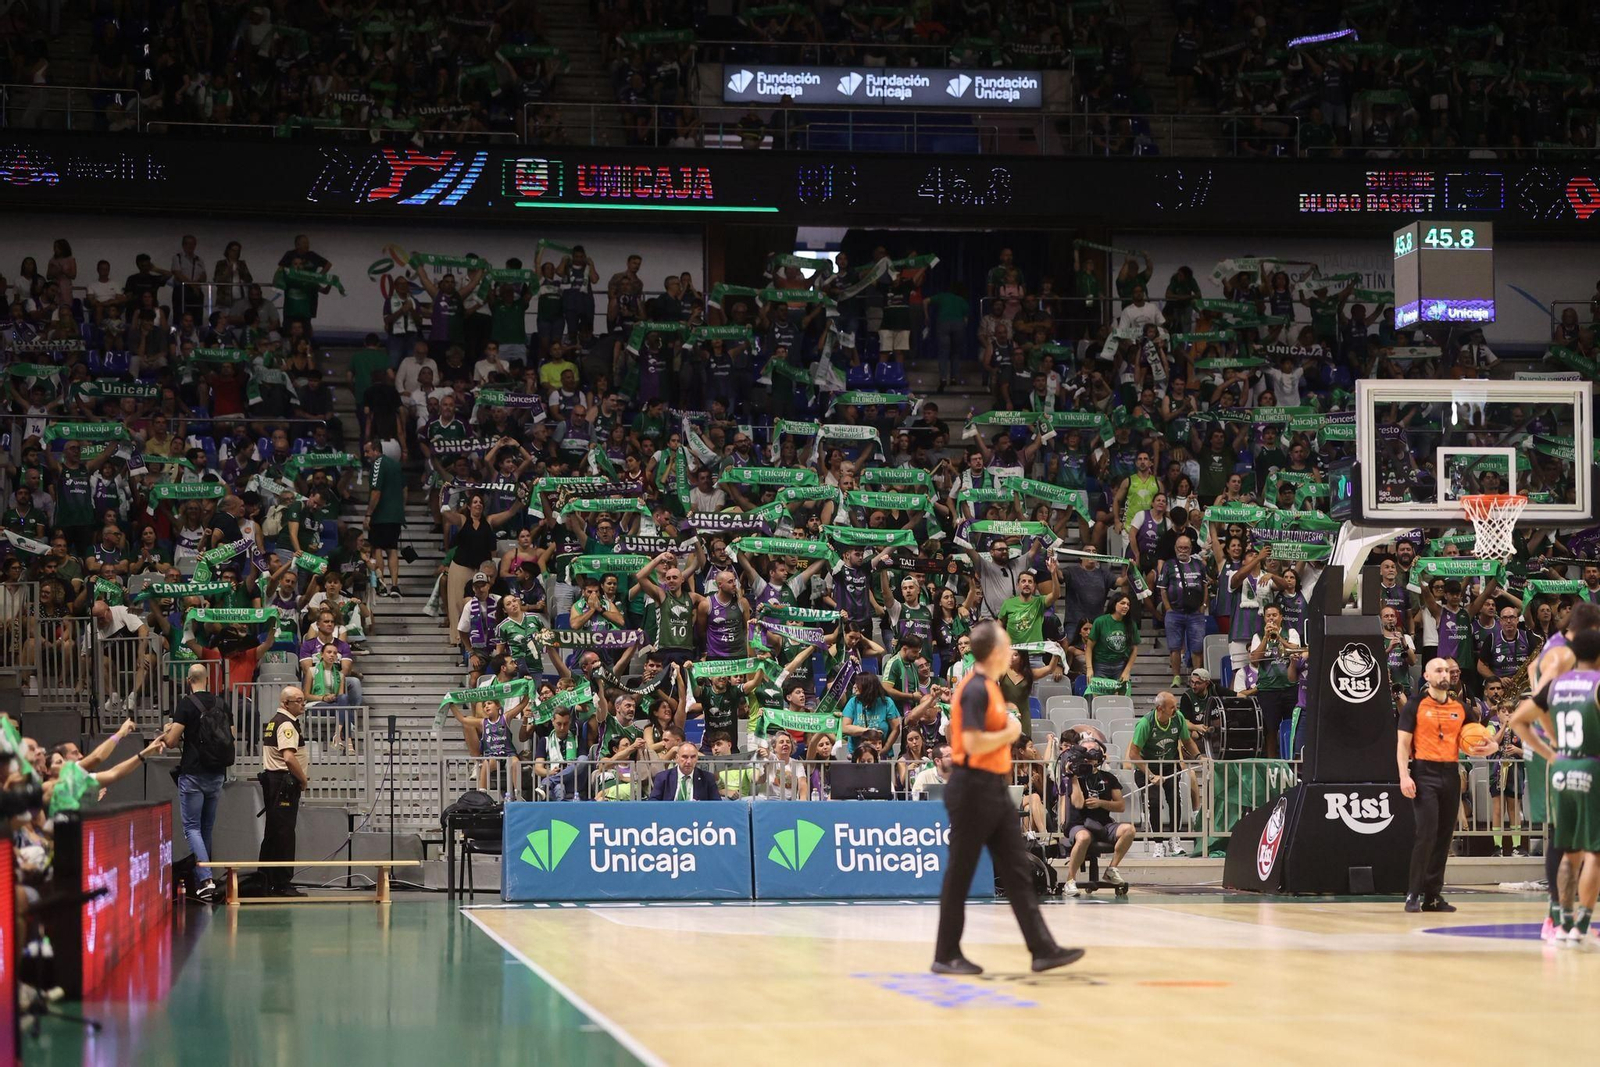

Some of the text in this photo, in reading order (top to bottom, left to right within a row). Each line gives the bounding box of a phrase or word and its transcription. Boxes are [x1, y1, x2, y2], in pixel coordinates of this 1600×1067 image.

[757, 71, 820, 85] Fundación
[866, 74, 929, 87] Fundación
[975, 76, 1037, 89] Fundación
[757, 83, 803, 97] Unicaja
[866, 85, 912, 100] Unicaja
[975, 87, 1020, 102] Unicaja
[577, 165, 714, 199] UNICAJA
[1395, 232, 1412, 257] 45.8
[1425, 228, 1474, 249] 45.8
[1448, 308, 1489, 321] Unicaja
[1267, 344, 1324, 356] UNICAJA
[102, 382, 158, 398] Unicaja
[1324, 427, 1353, 439] Unicaja
[434, 437, 500, 454] UNICAJA
[758, 469, 791, 480] Unicaja
[879, 470, 912, 480] Unicaja
[176, 484, 209, 494] Unicaja
[565, 481, 638, 494] UNICAJA
[597, 497, 631, 507] Unicaja
[875, 493, 907, 503] Unicaja
[687, 513, 763, 529] UNICAJA
[988, 527, 1028, 535] BALONCESTO
[769, 540, 803, 550] Unicaja
[1273, 544, 1302, 552] UNICAJA
[607, 556, 644, 567] Unicaja
[1269, 551, 1308, 560] ALONCESTO
[899, 558, 915, 567] TAU
[1444, 560, 1478, 570] Unicaja
[1444, 567, 1479, 576] histórico
[560, 630, 638, 645] UNICAJA
[671, 626, 687, 638] 10
[721, 633, 735, 643] 45
[1337, 677, 1372, 695] Risi
[781, 712, 821, 725] Unicaja
[781, 719, 824, 732] histórico
[1556, 710, 1584, 749] 13
[1323, 792, 1394, 828] Risi
[590, 821, 737, 847] Fundación
[591, 848, 696, 879] Unicaja
[836, 848, 940, 879] Unicaja
